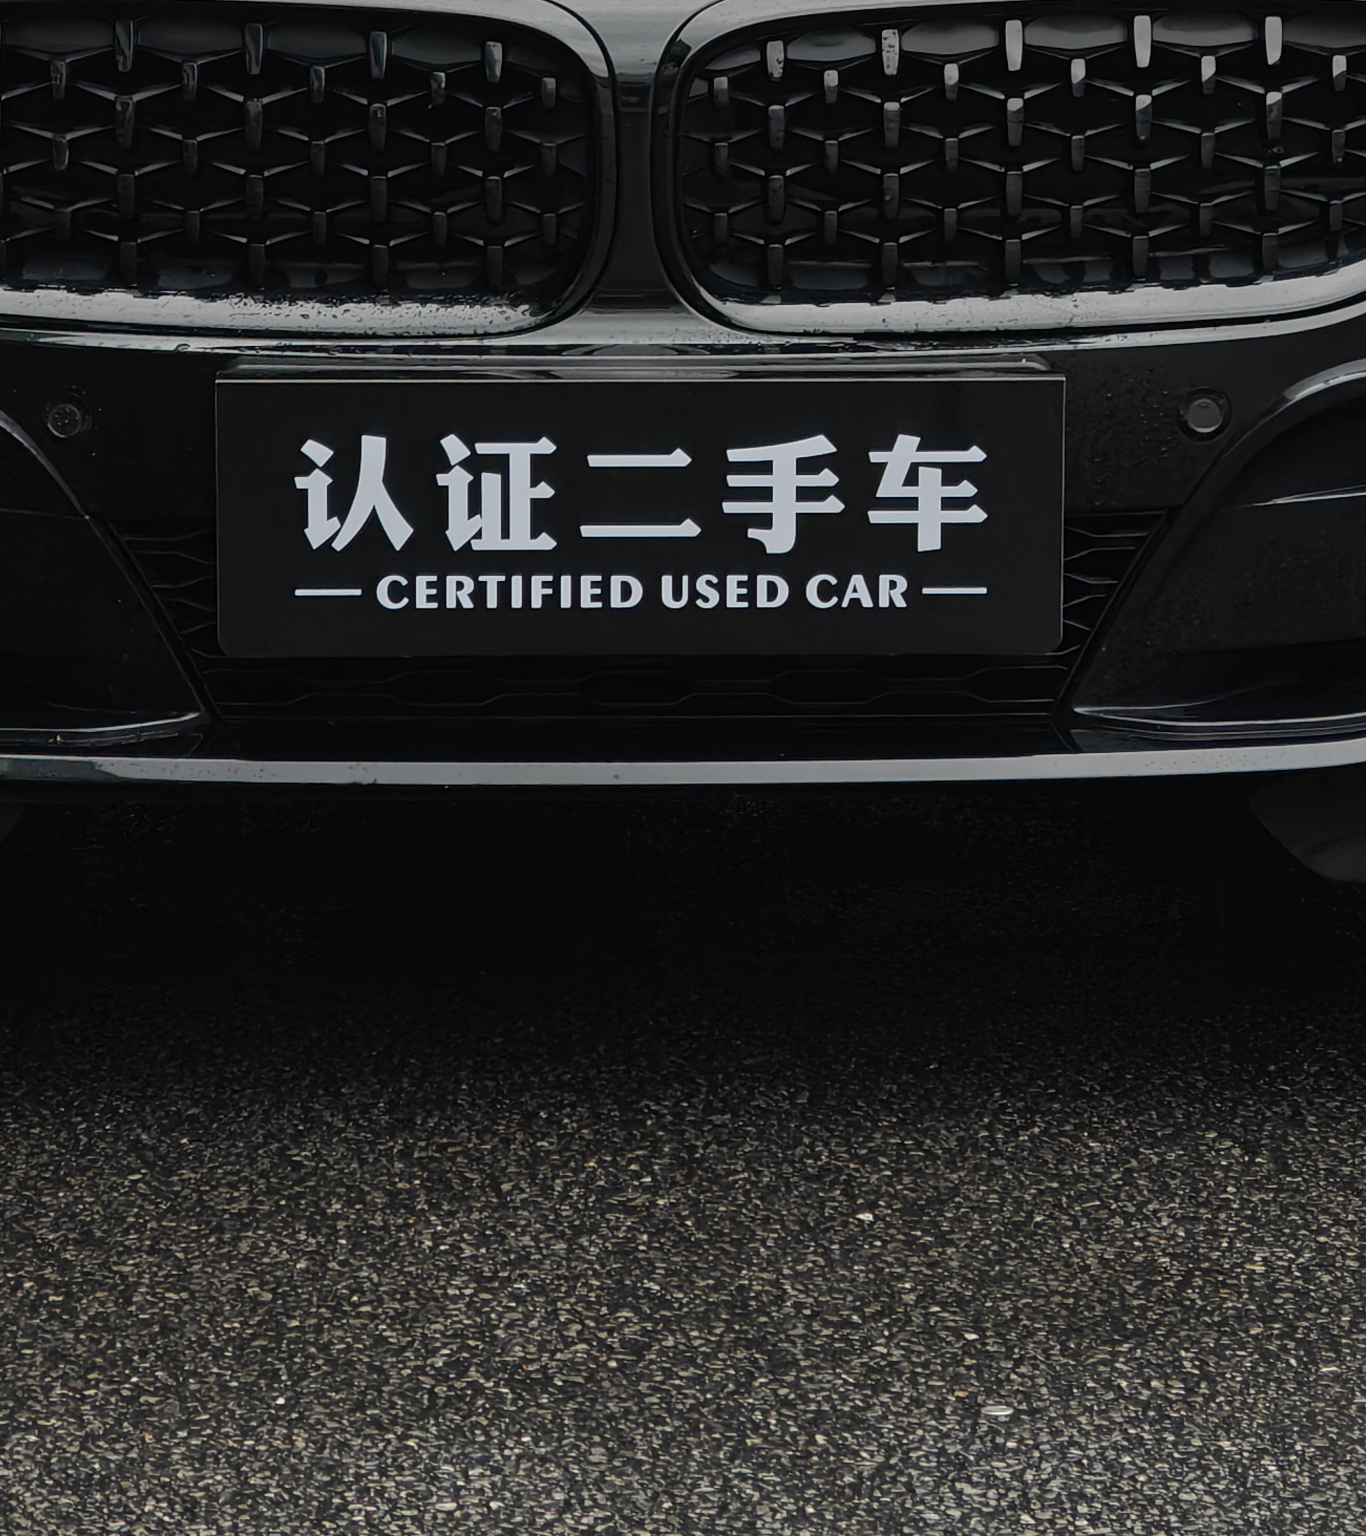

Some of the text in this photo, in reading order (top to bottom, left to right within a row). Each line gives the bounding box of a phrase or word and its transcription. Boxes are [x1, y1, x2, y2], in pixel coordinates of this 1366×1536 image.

[294, 433, 989, 555] 认证二手车
[376, 573, 909, 610] CERTIFIED USED CAR
